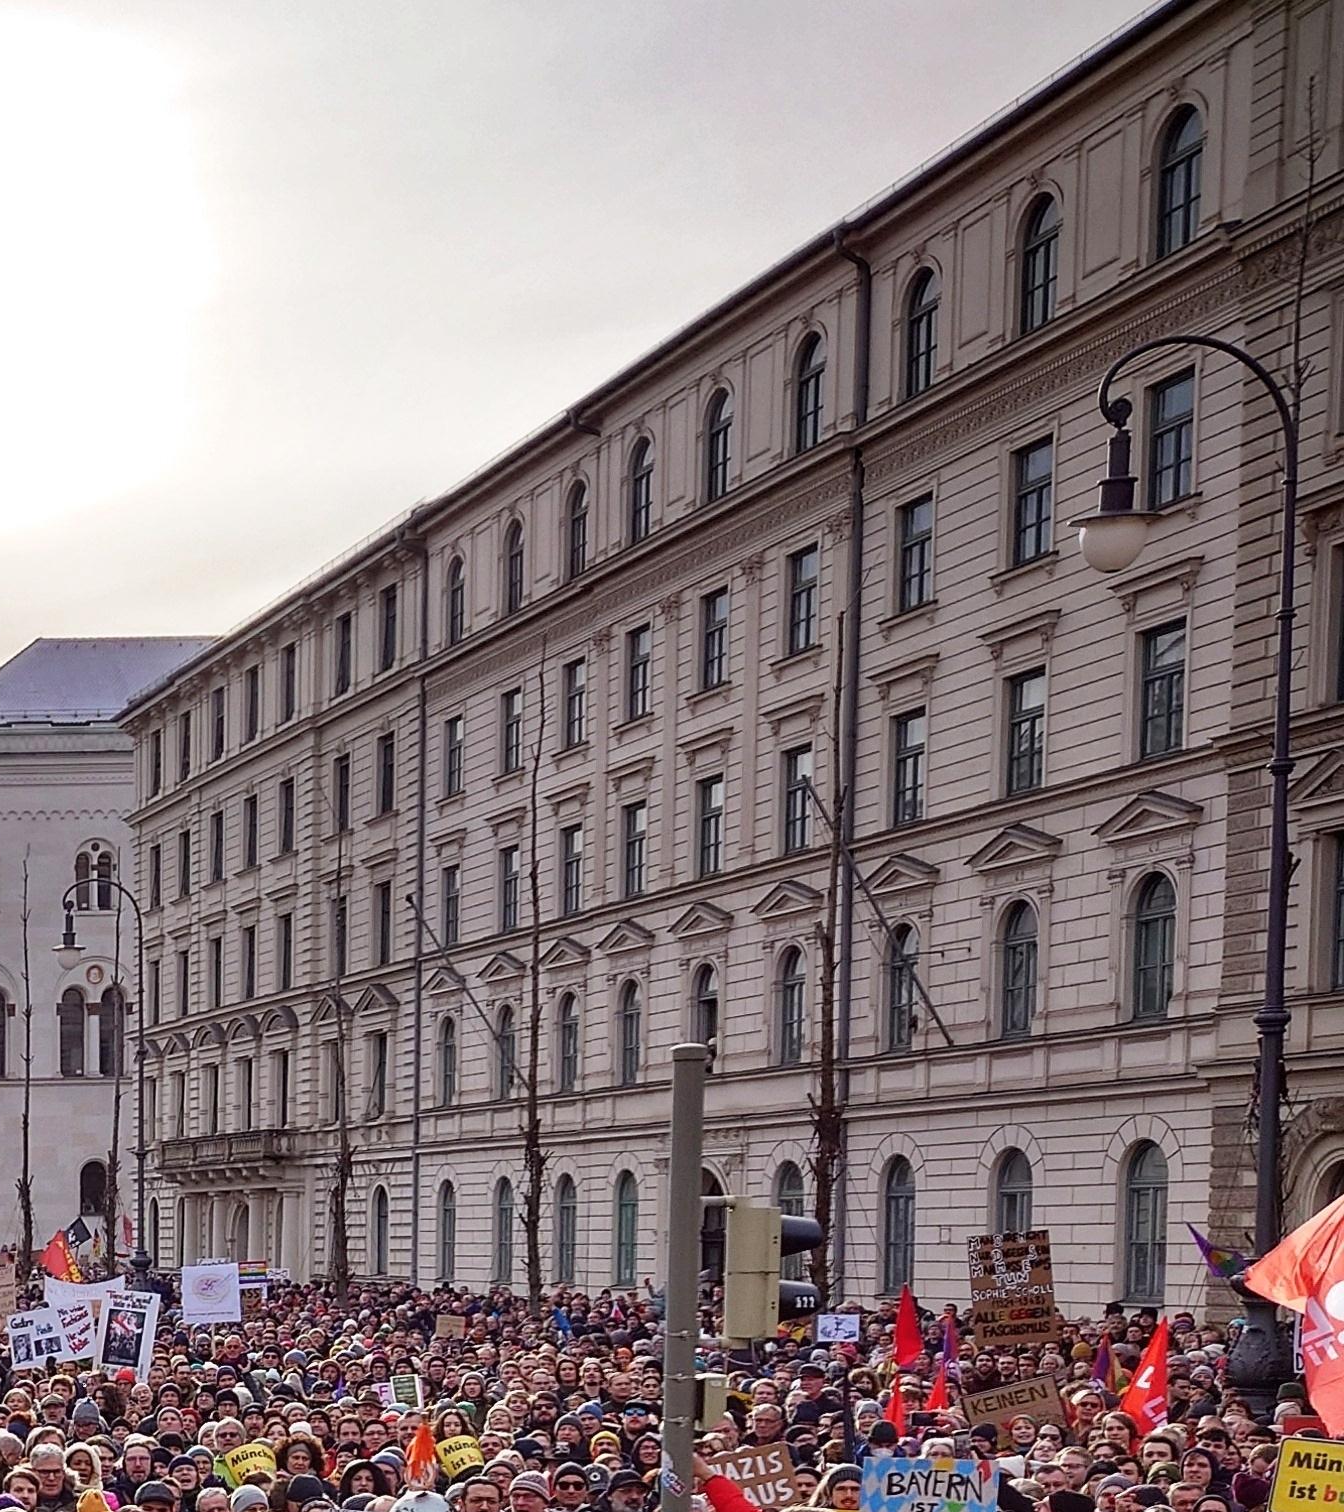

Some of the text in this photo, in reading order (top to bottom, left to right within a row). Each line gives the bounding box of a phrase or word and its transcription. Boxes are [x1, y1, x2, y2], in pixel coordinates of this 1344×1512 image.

[972, 1284, 1054, 1301] SOPHIE SCHOLL
[975, 1305, 1051, 1325] ALLE GEGEN
[982, 1321, 1051, 1338] FASCHISMUS
[970, 1383, 1048, 1415] KEINEN
[886, 1469, 984, 1502] BAYERN
[1289, 1480, 1318, 1501] ist
